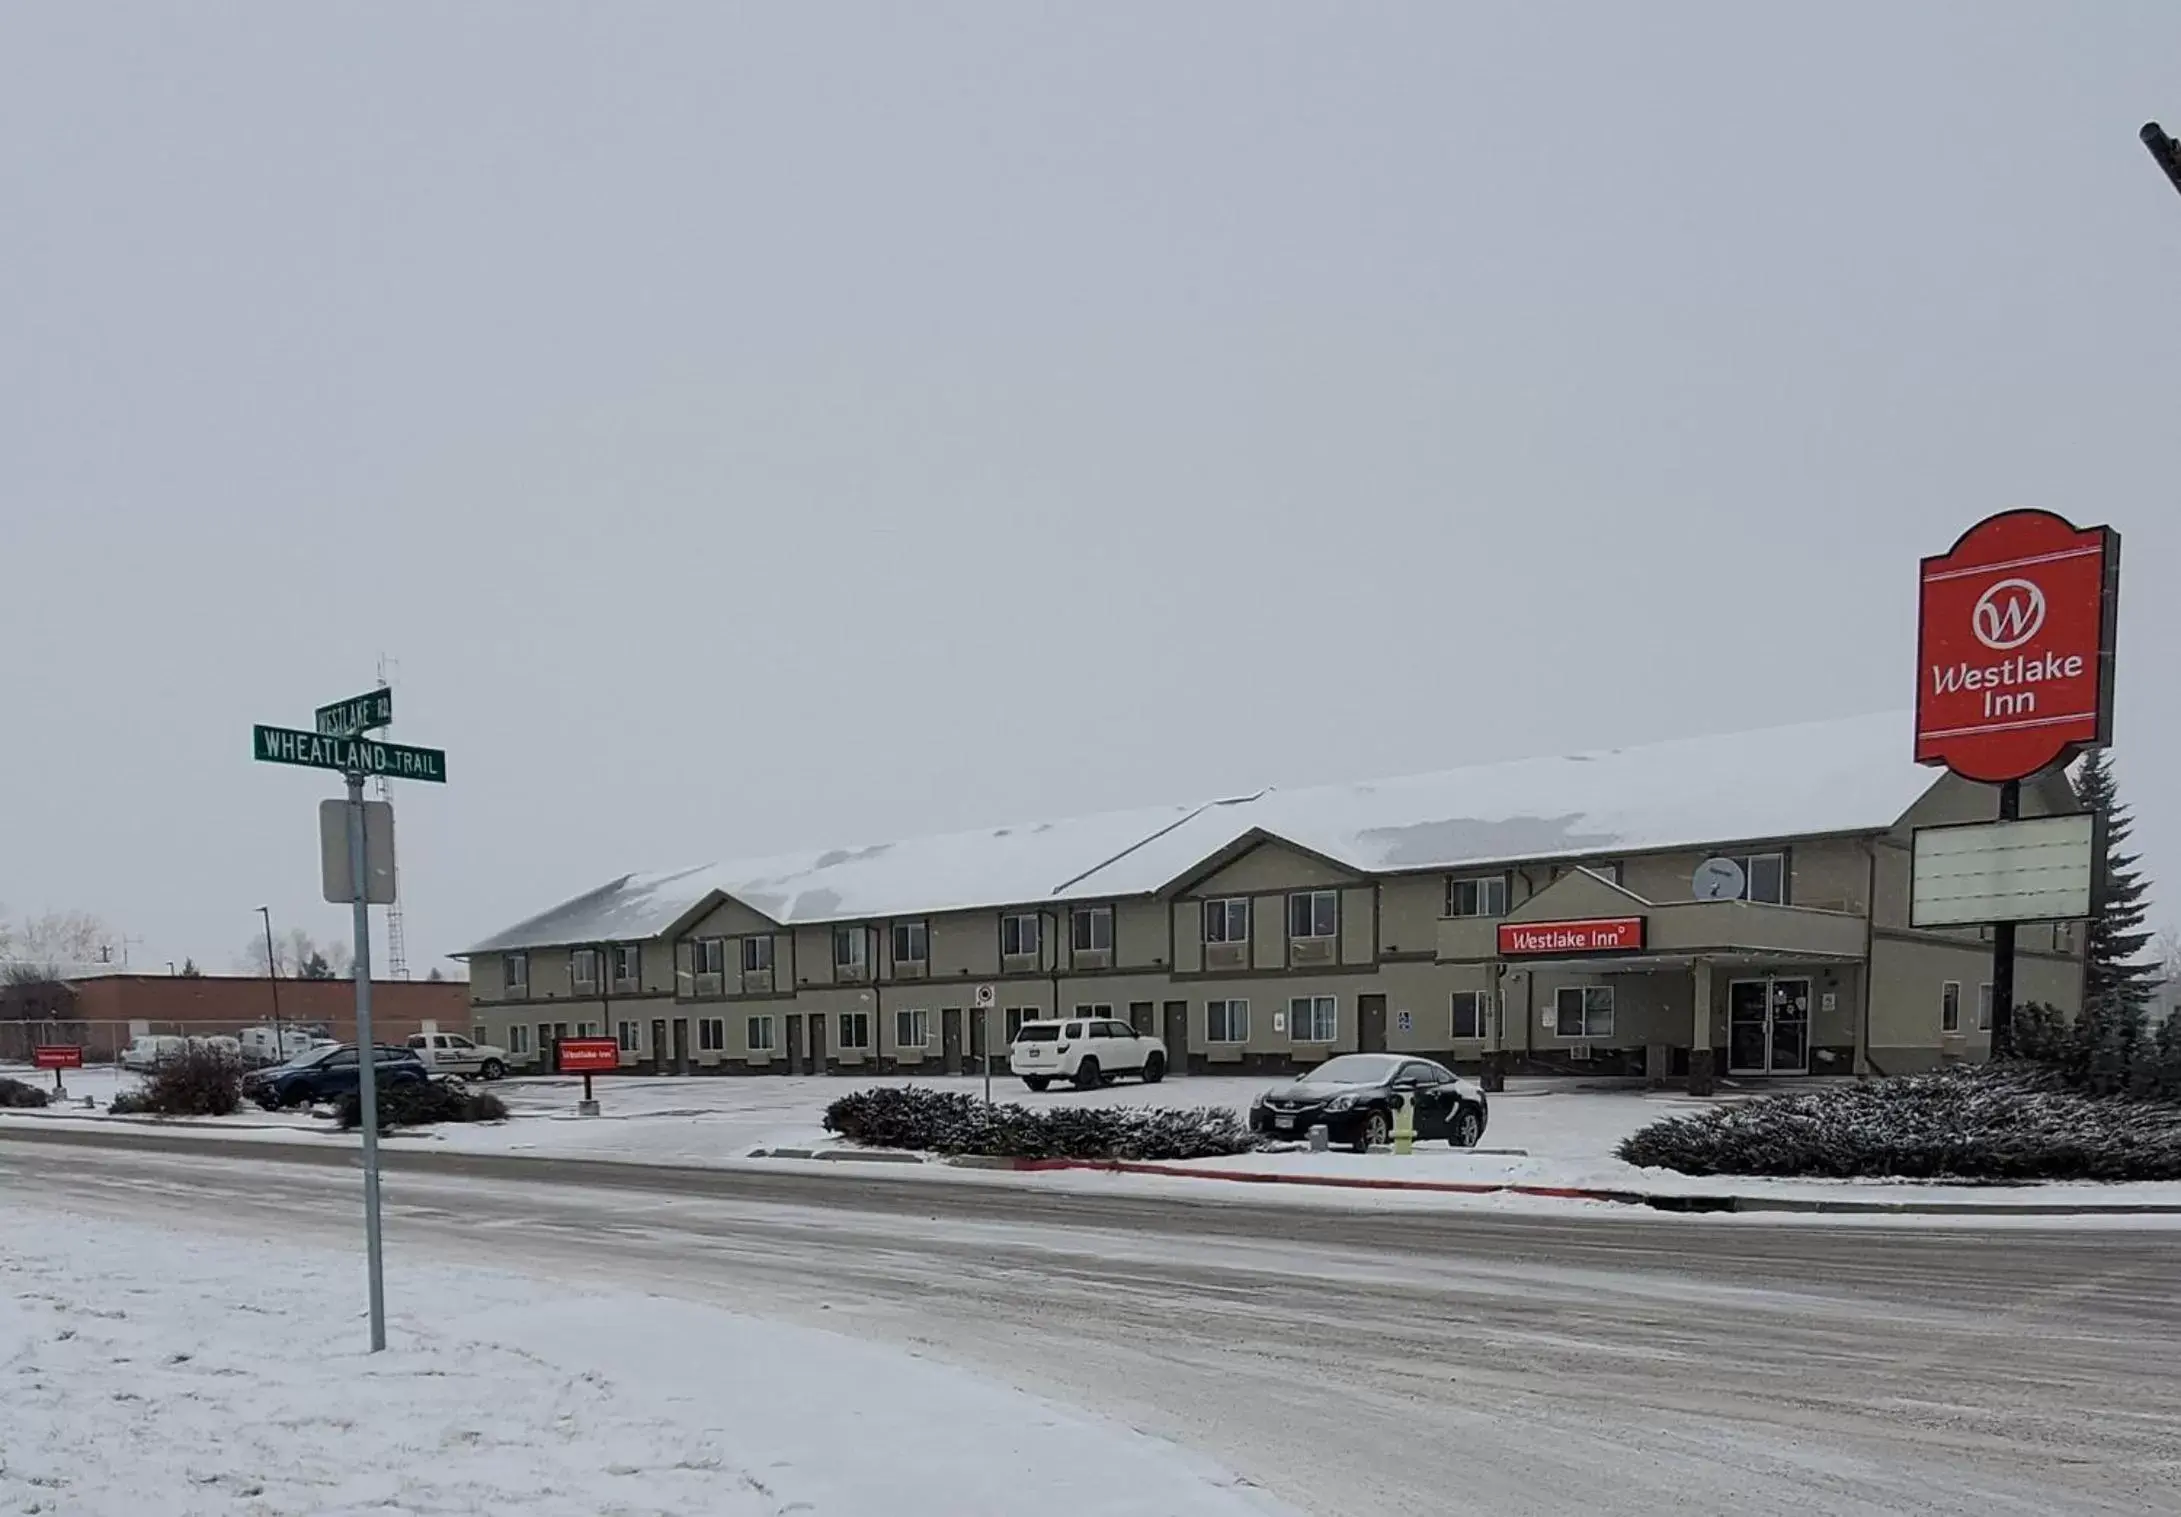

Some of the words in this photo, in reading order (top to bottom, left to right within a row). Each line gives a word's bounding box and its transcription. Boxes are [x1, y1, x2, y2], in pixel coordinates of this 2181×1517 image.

[1932, 651, 2083, 695] Westlake
[1984, 690, 2035, 718] Inn
[264, 730, 386, 770] WHEATLAND
[395, 751, 438, 774] TRAIL
[1512, 930, 1585, 949] Westlake
[1592, 931, 1618, 946] Inn
